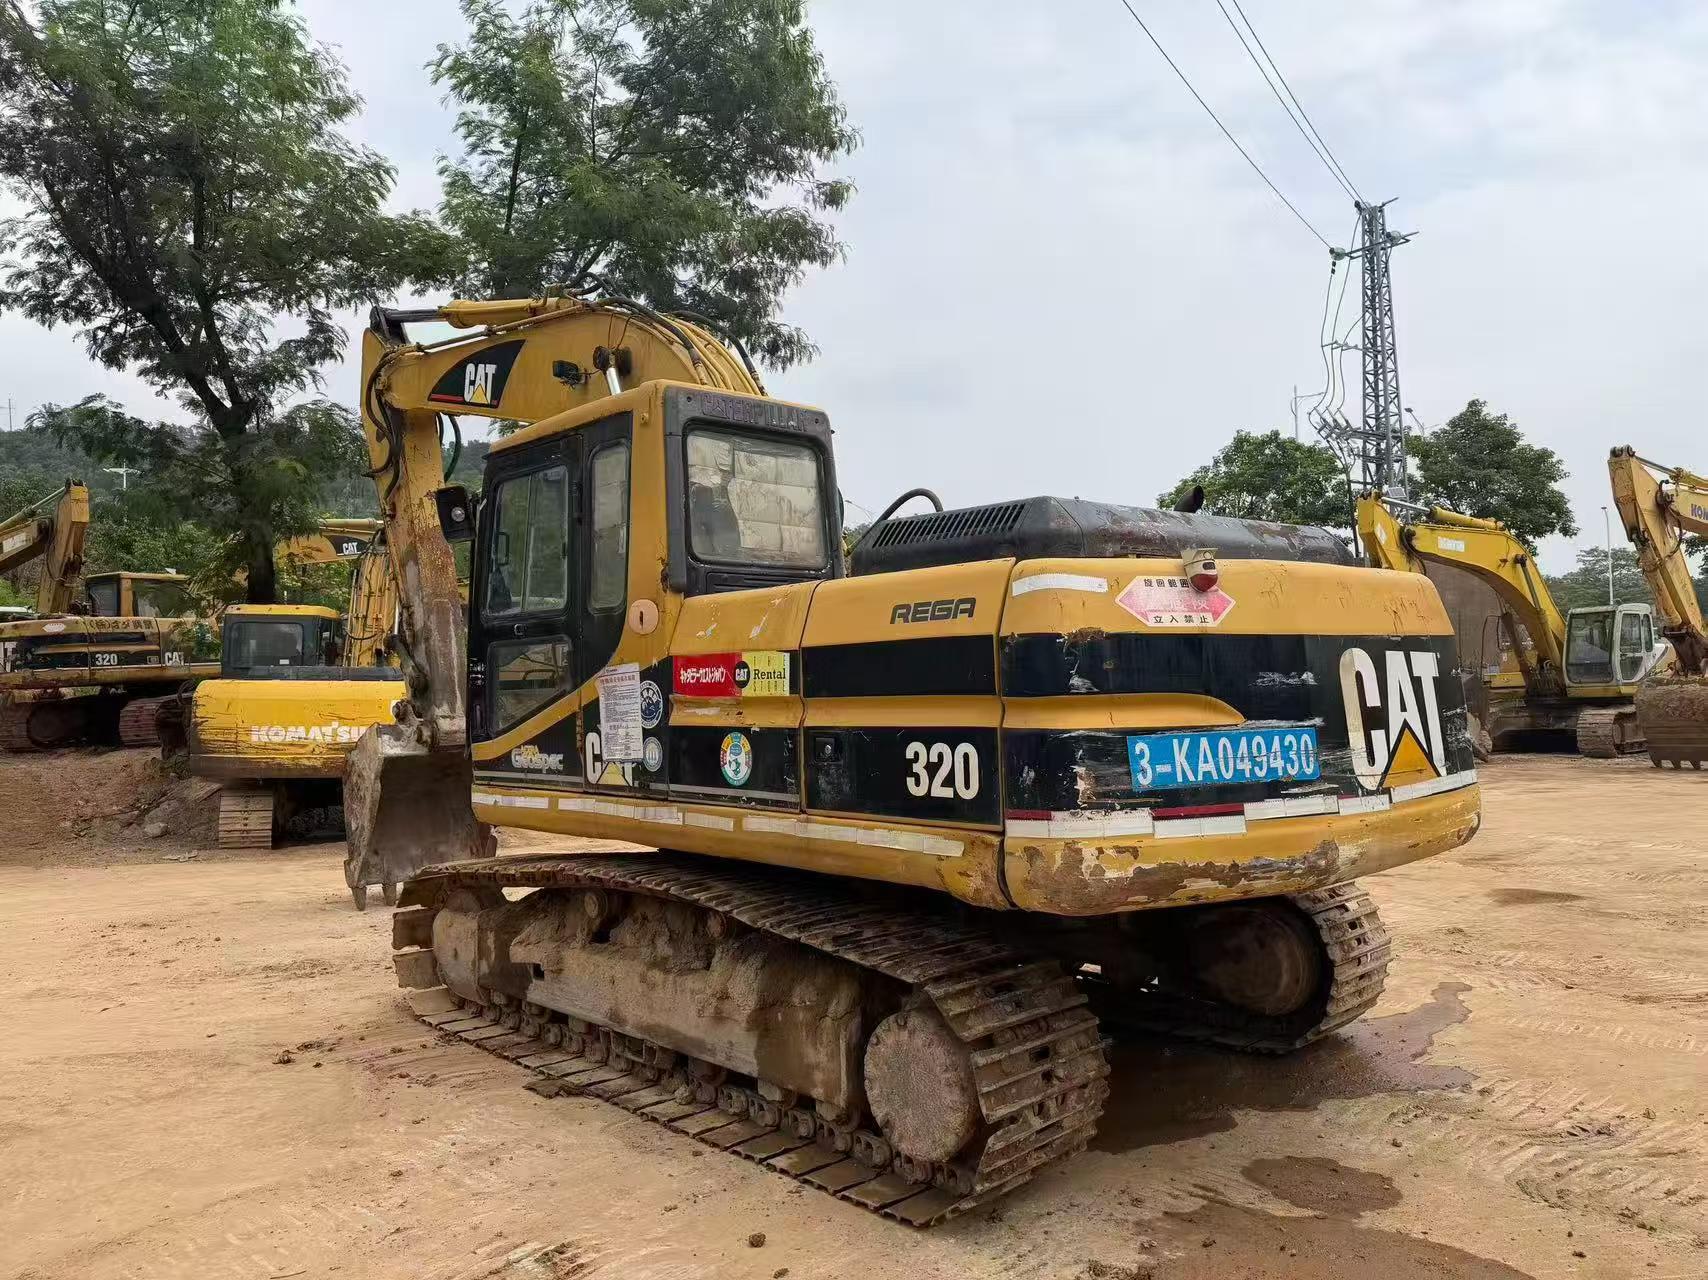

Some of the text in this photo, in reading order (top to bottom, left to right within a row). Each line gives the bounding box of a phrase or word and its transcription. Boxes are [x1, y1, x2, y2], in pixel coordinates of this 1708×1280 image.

[464, 363, 497, 404] CAT
[342, 541, 358, 555] CAT
[890, 597, 977, 625] REGA
[1153, 614, 1209, 624] 立入禁止
[95, 653, 118, 666] 320
[735, 668, 787, 681] CAT Rental
[1339, 647, 1448, 791] CAT
[905, 741, 979, 800] 320
[1134, 733, 1315, 786] 3-KA049430
